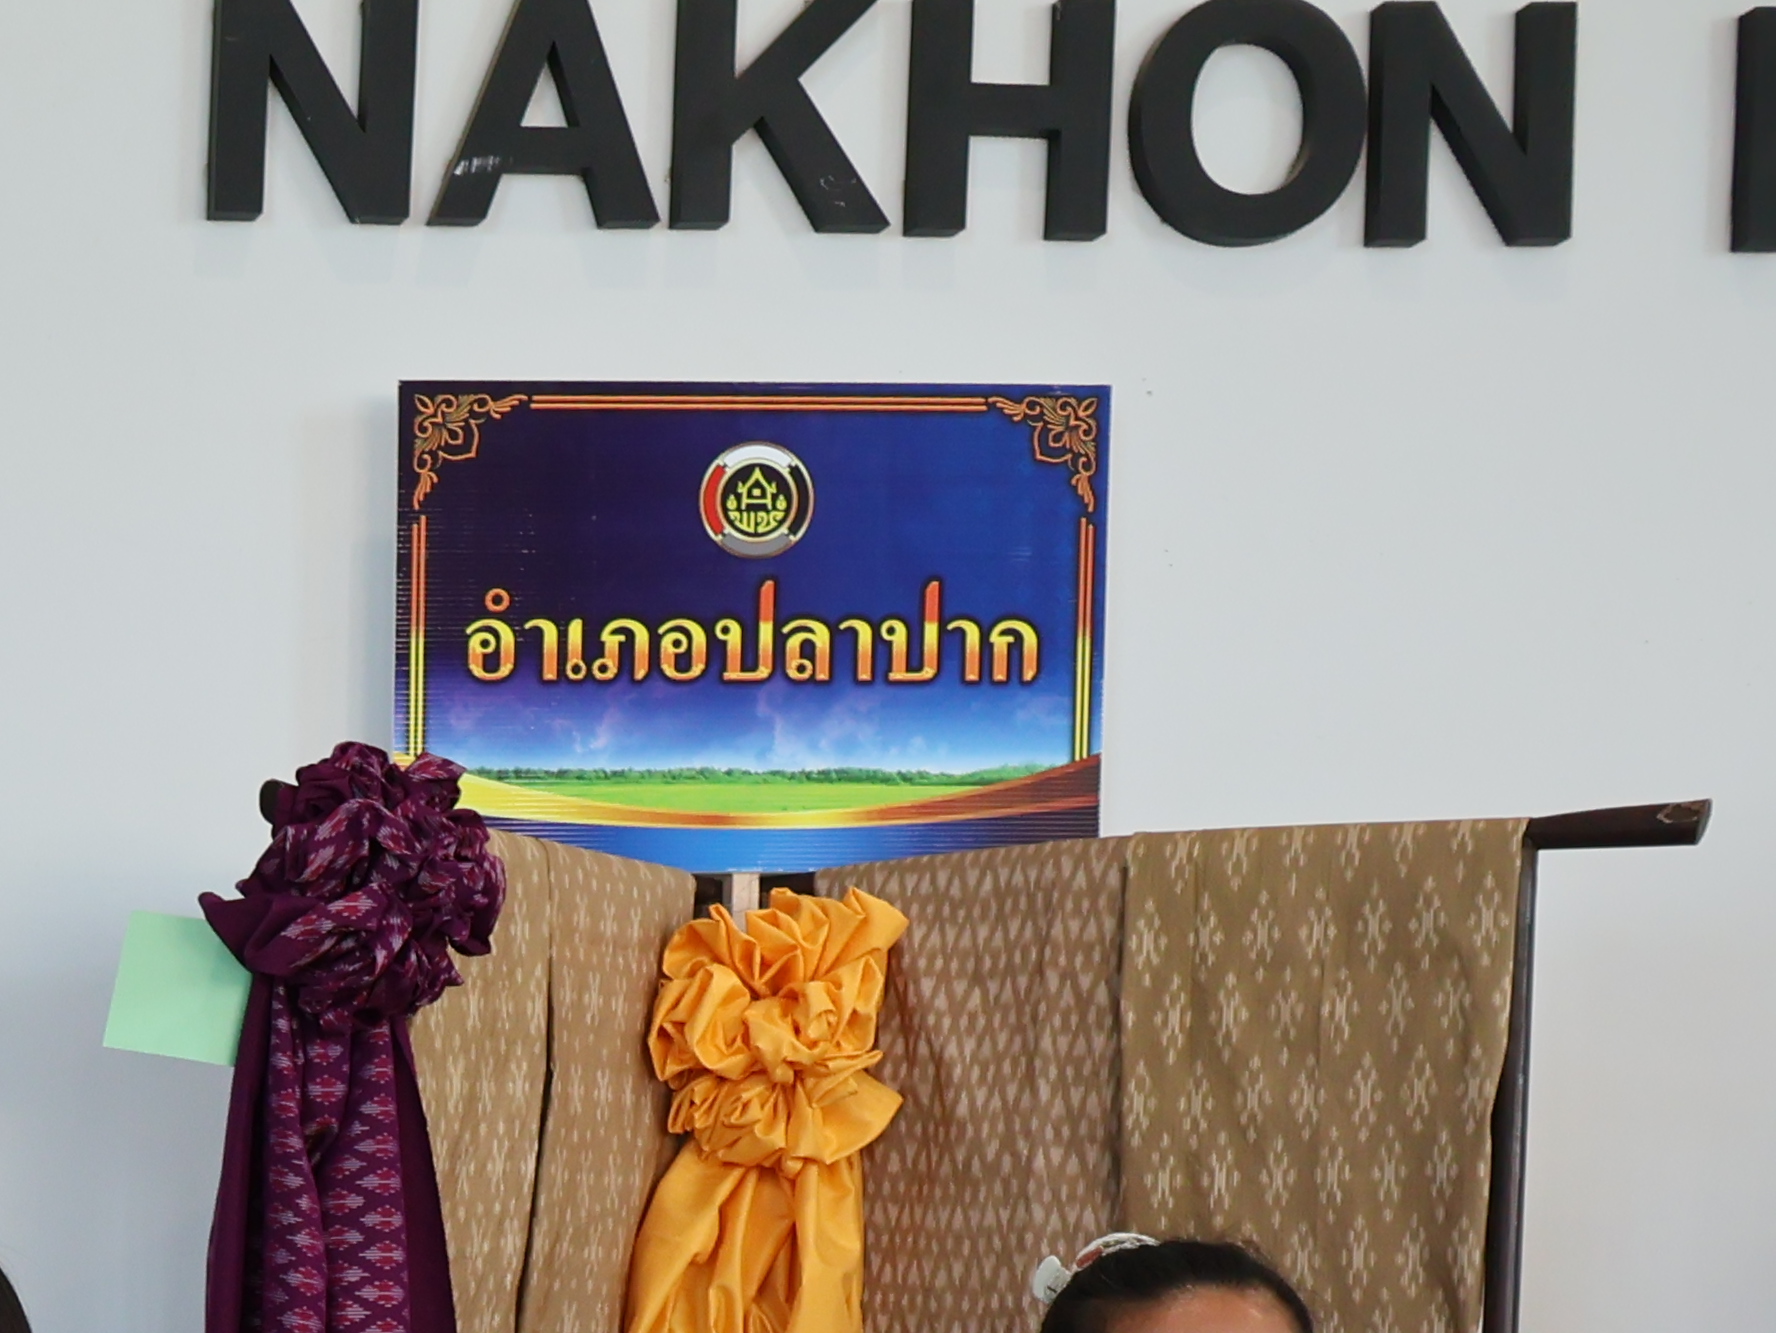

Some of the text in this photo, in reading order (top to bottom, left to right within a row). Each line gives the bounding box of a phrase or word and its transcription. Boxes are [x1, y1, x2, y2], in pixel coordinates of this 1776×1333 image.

[206, 0, 1575, 249] NAKHON
[463, 579, 1041, 687] อำเภอปลาปาก
